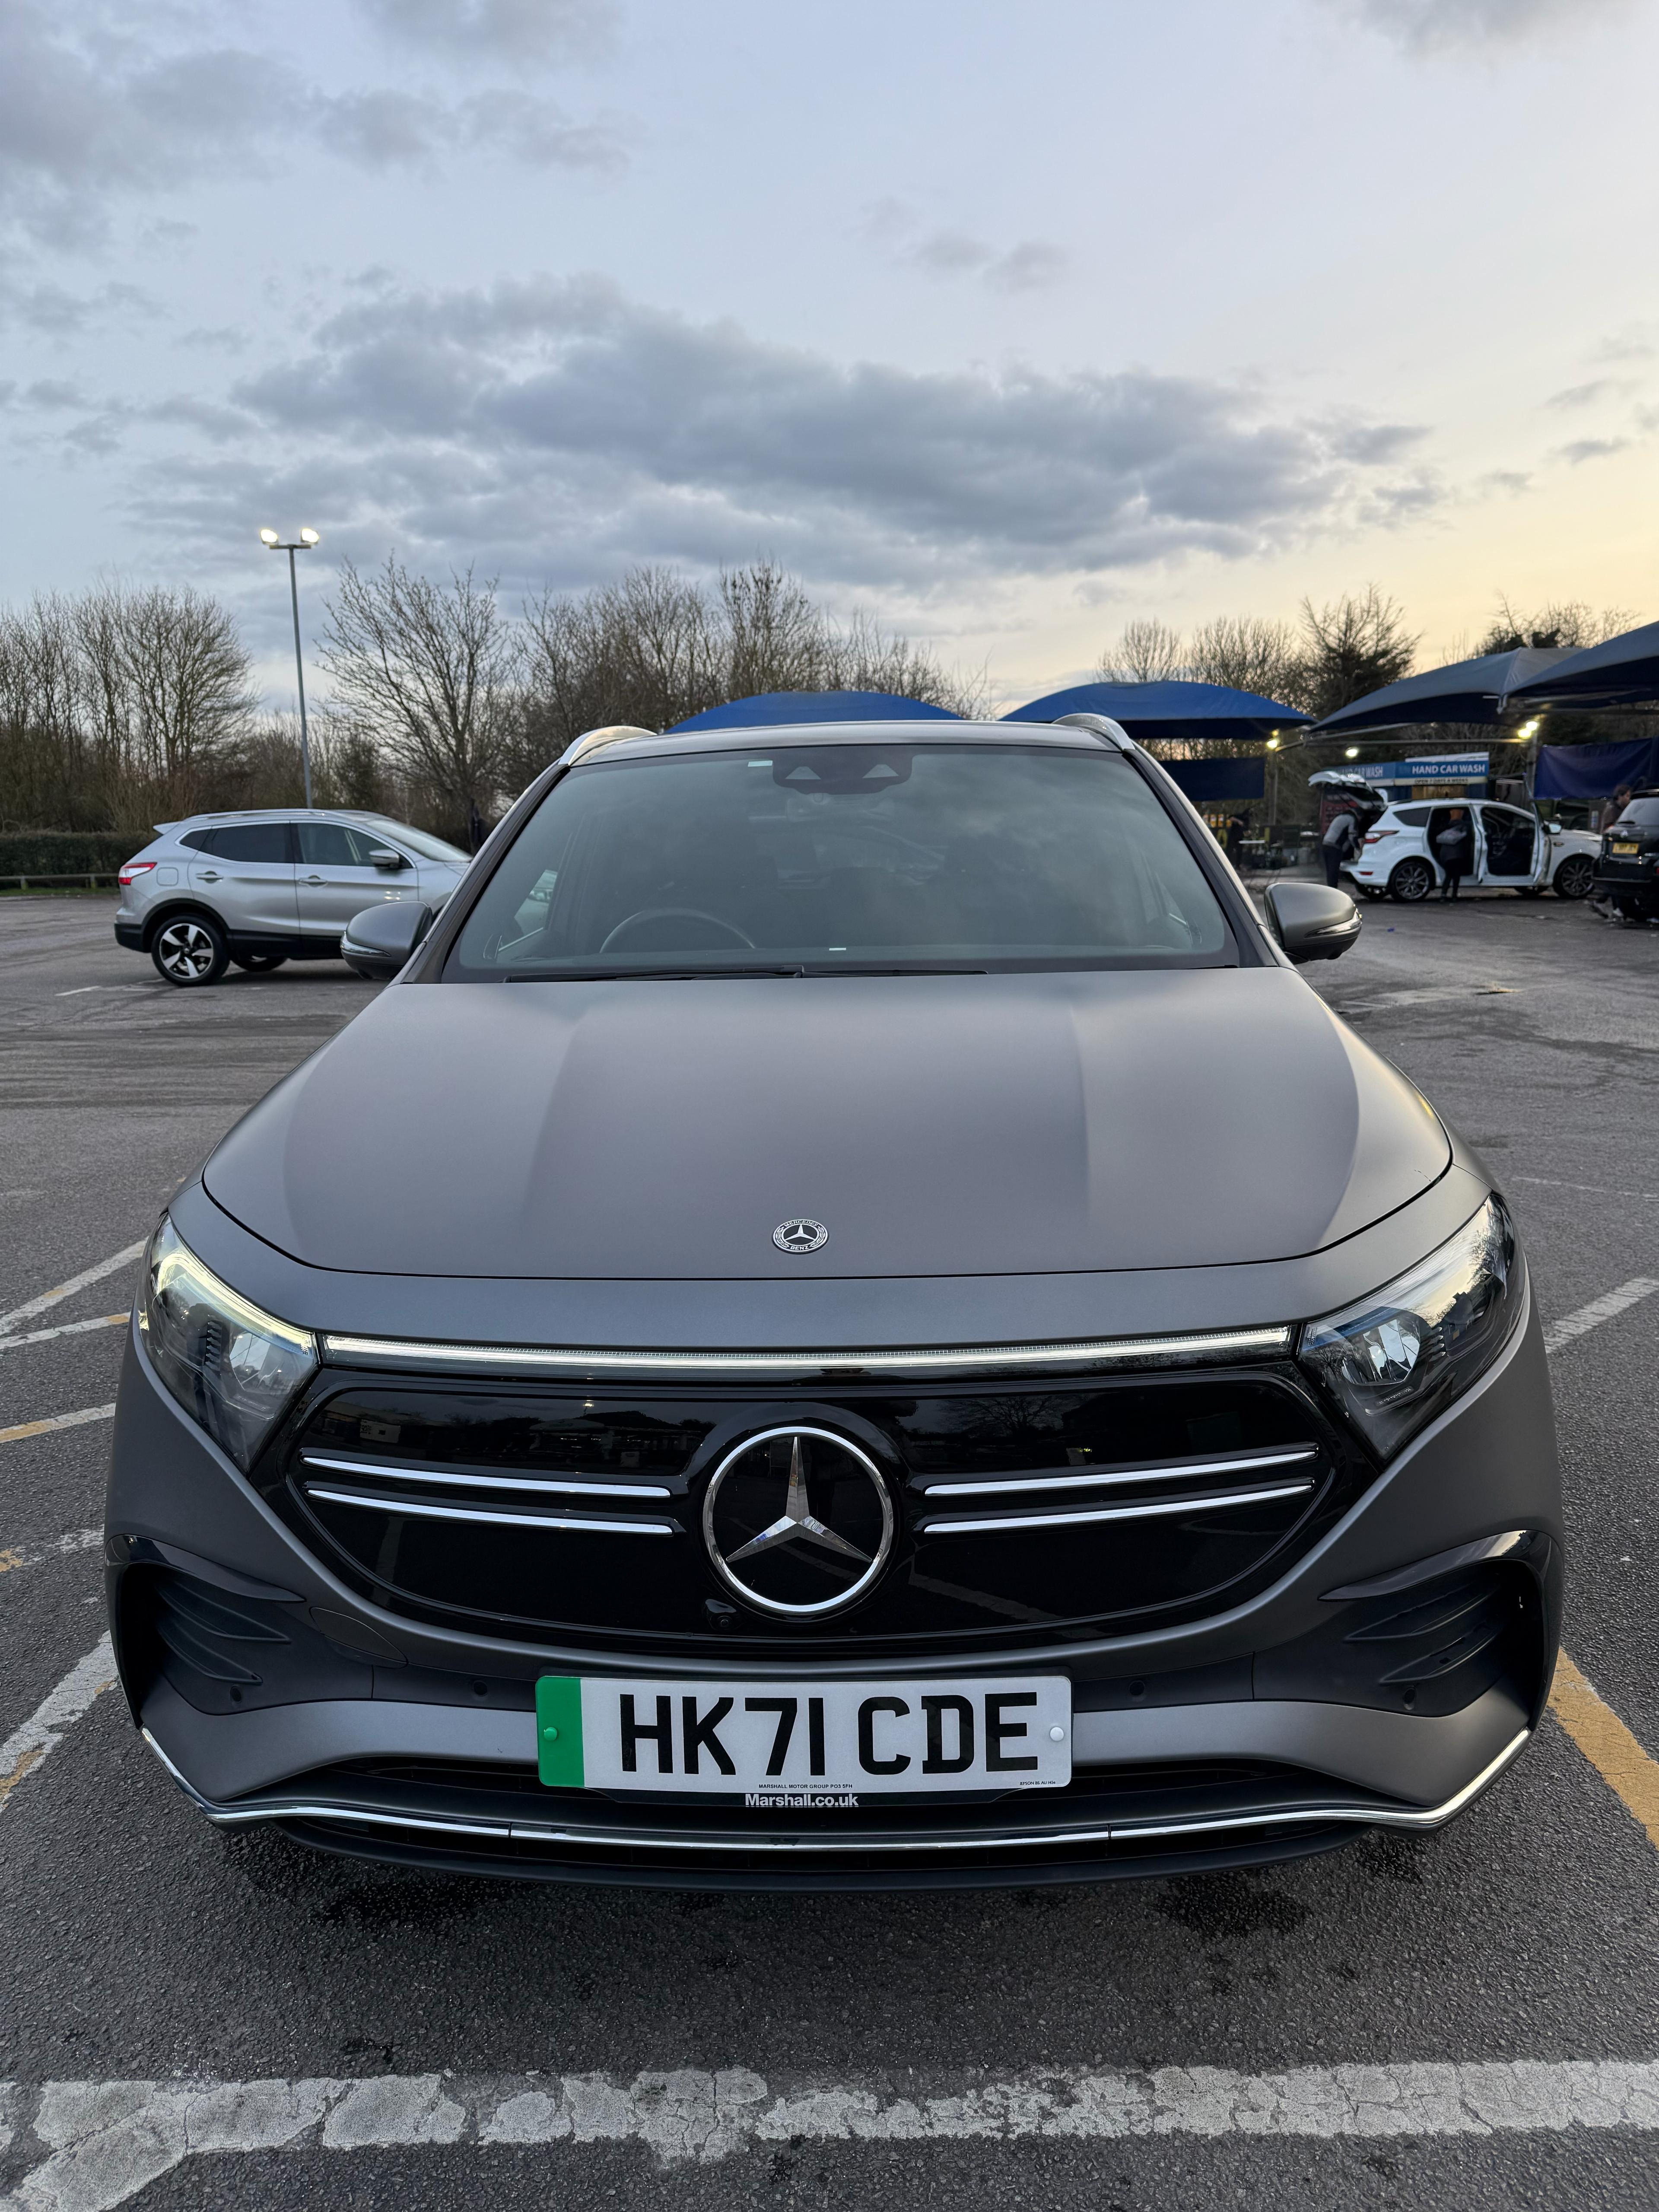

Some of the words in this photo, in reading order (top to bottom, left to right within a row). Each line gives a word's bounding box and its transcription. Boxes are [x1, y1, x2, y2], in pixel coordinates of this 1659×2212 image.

[1365, 766, 1383, 778] WASH
[1412, 765, 1439, 774] HAND
[1440, 765, 1459, 774] CAR
[1459, 764, 1485, 773] WASH
[620, 1694, 825, 1776] HK71
[858, 1692, 1038, 1775] CDE
[745, 1793, 859, 1806] Marshall.co.uk
